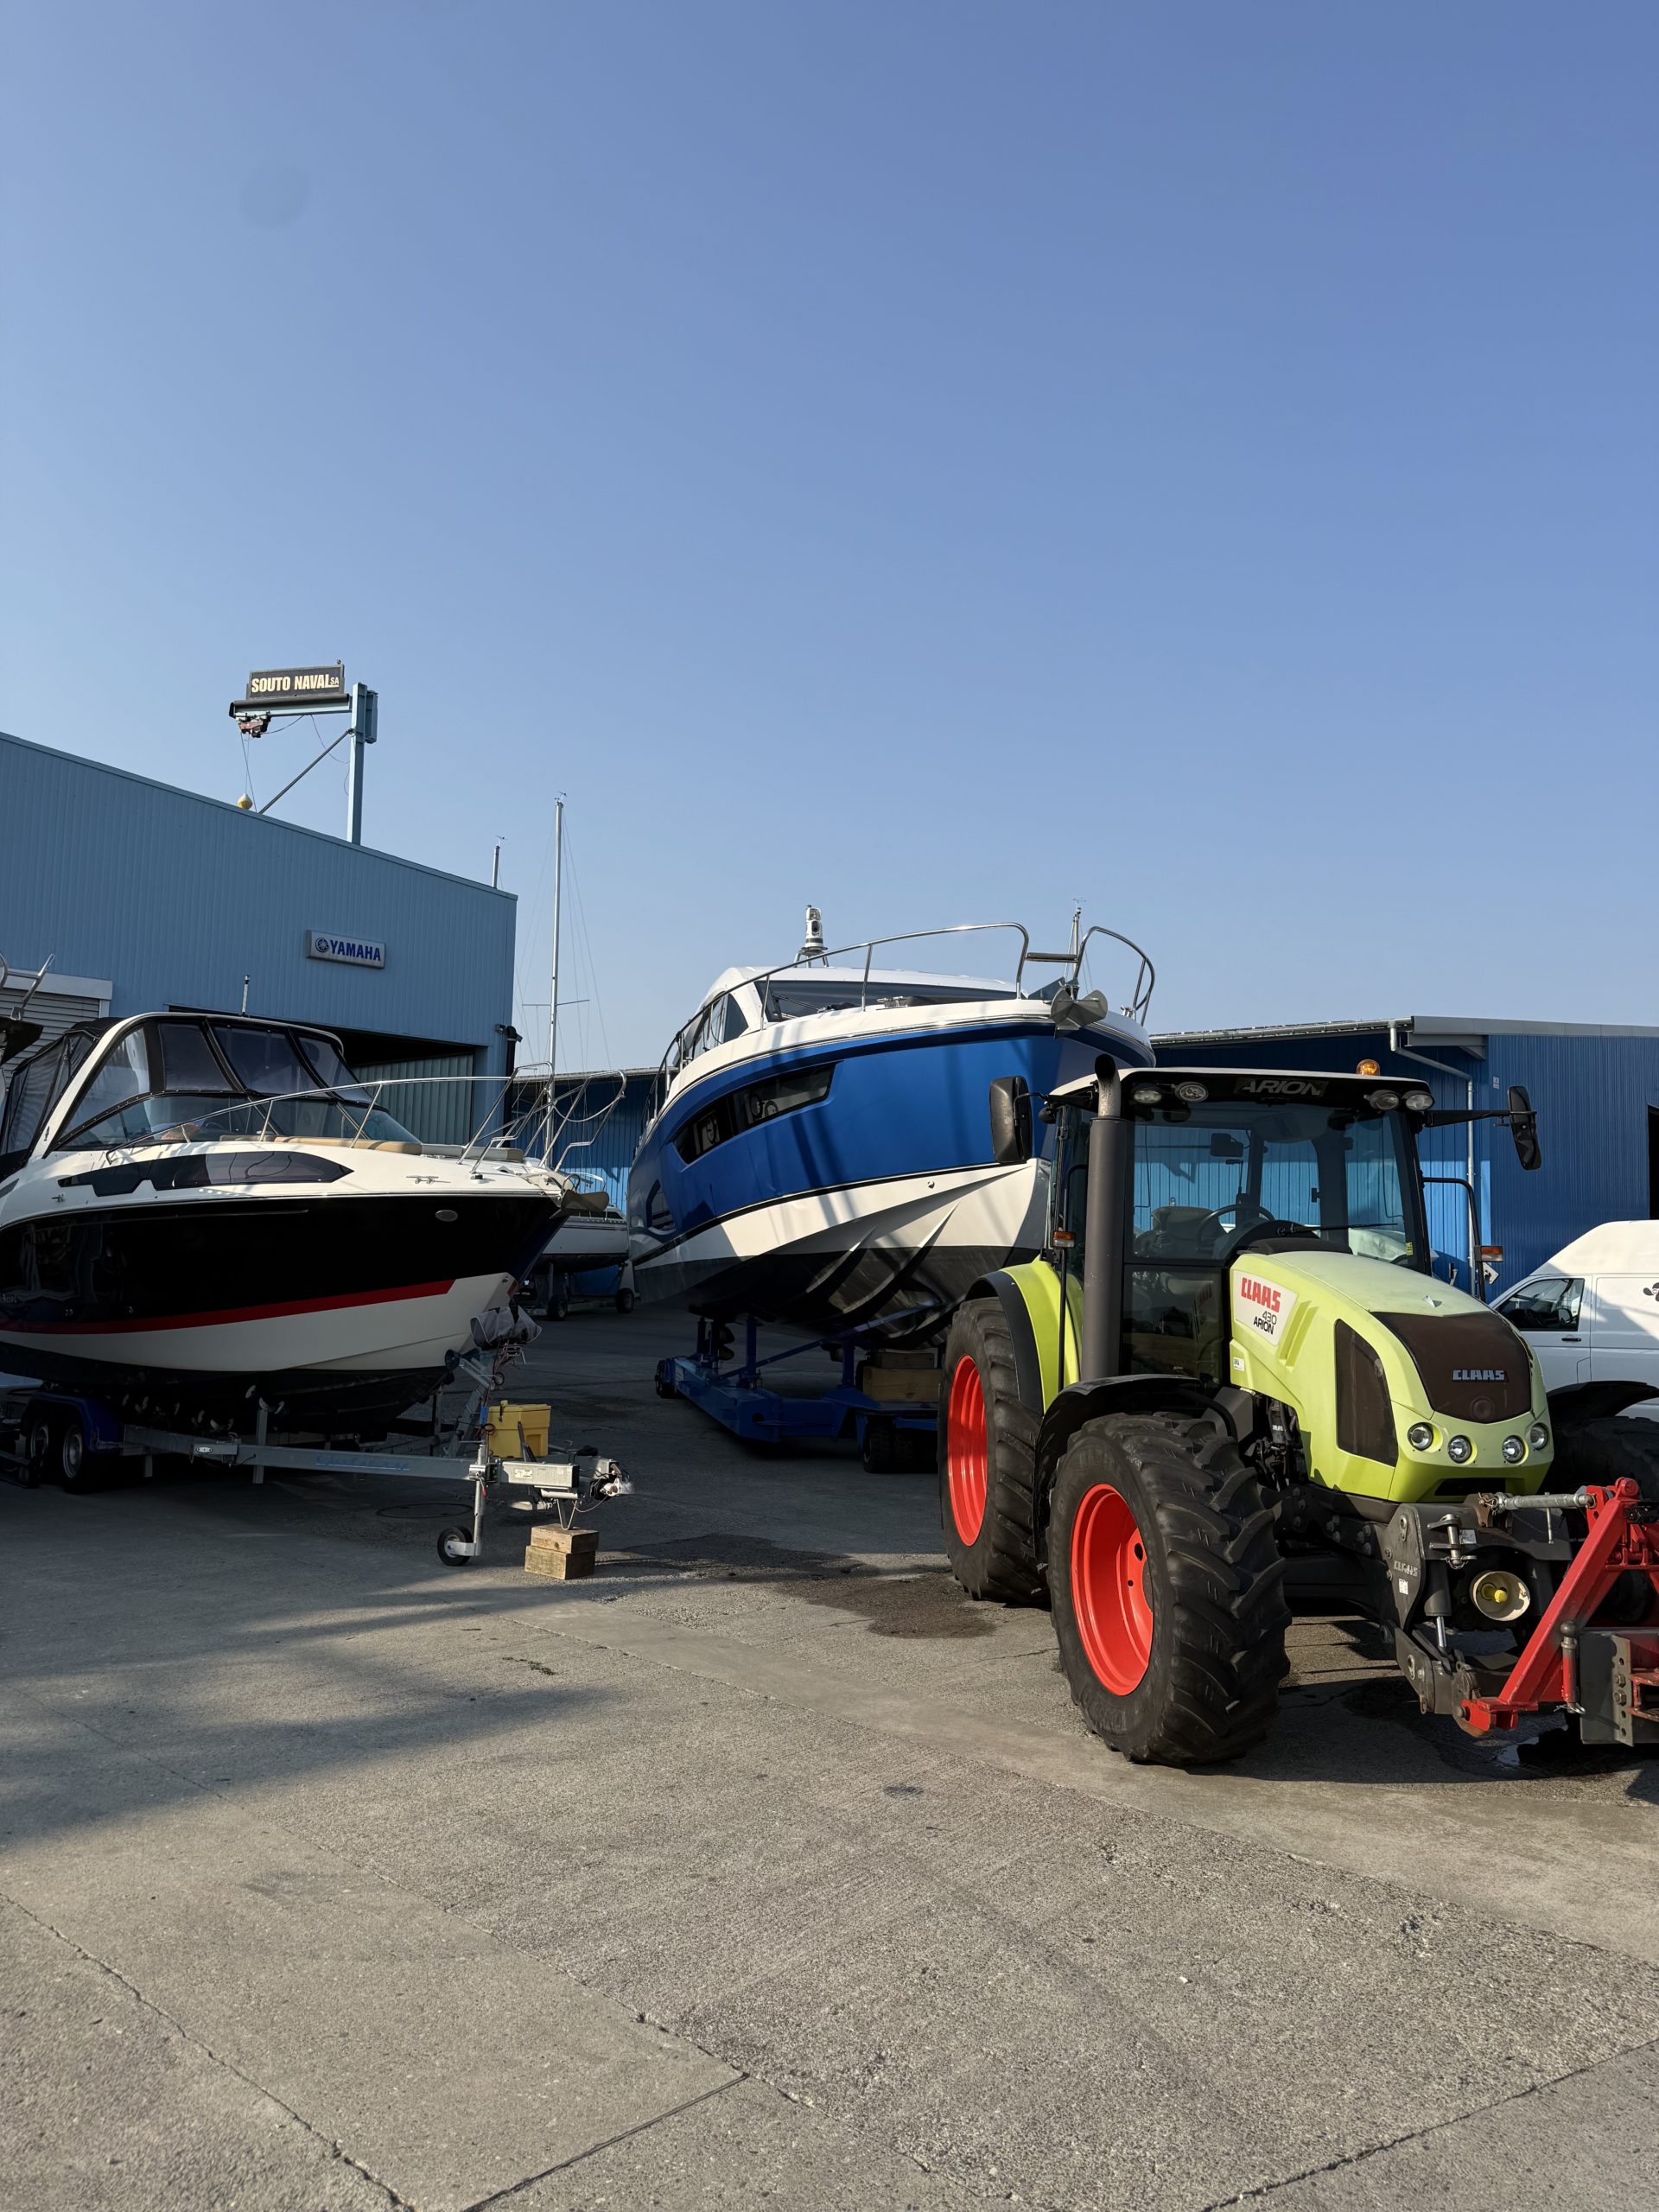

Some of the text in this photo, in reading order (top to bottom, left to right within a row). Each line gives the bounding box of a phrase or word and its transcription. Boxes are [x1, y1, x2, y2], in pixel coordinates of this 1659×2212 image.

[251, 677, 290, 692] SOUTO
[295, 674, 339, 690] NAVAL
[330, 940, 381, 961] YAMAHA
[1243, 1080, 1323, 1096] ARION
[1242, 1277, 1281, 1313] CLAAS
[1253, 1316, 1274, 1335] ARION
[1262, 1311, 1277, 1325] 430
[1452, 1370, 1505, 1381] CLAAS
[1394, 1560, 1418, 1577] CLAAS
